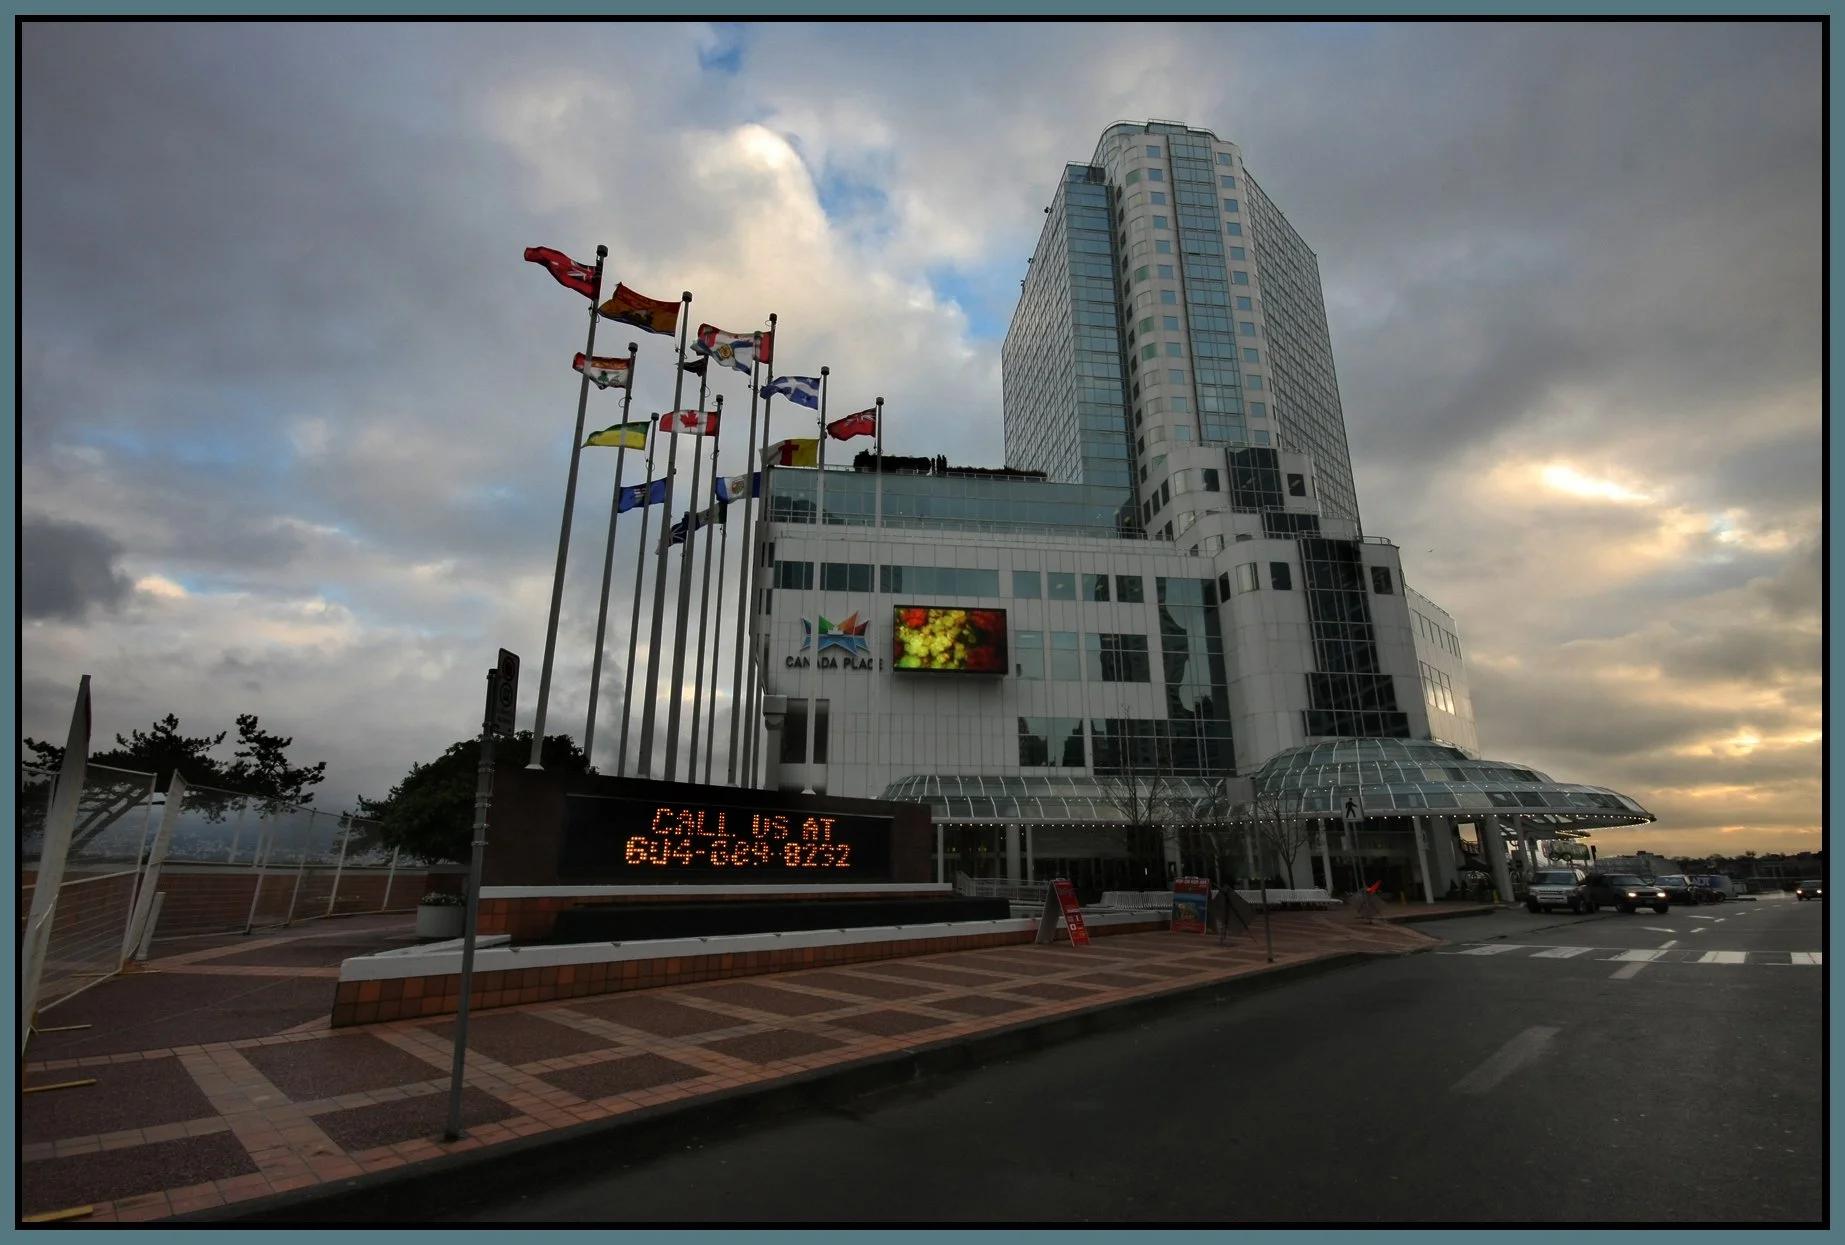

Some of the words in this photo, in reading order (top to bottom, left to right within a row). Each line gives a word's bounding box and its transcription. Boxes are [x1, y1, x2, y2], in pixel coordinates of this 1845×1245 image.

[652, 808, 736, 837] CALL
[752, 814, 788, 839] US
[802, 817, 835, 841] AT
